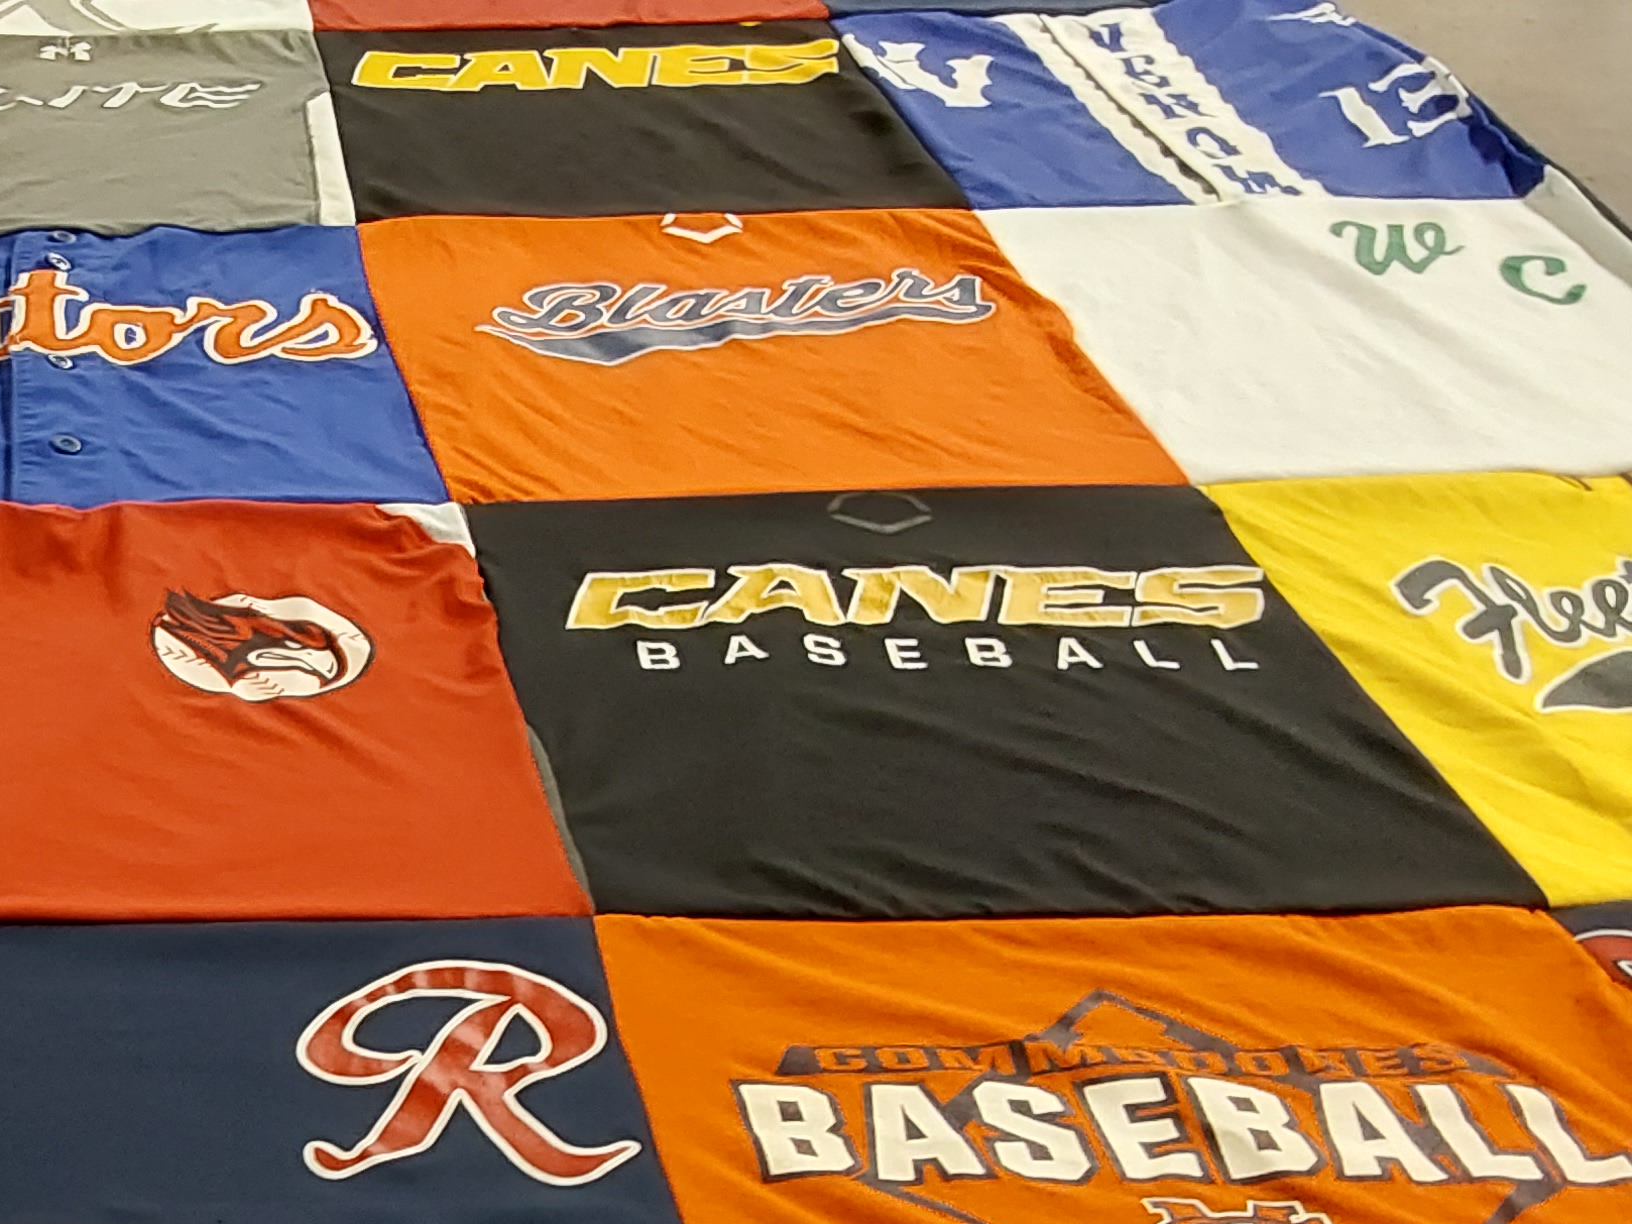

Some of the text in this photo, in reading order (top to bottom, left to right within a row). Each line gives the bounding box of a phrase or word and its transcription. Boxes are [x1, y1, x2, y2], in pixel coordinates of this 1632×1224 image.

[351, 38, 841, 92] CANES
[491, 268, 982, 334] Blasters
[565, 563, 1265, 628] CANES
[636, 633, 1260, 670] BASEBALL
[295, 959, 642, 1187] R
[732, 1077, 1632, 1188] BASEBALL
